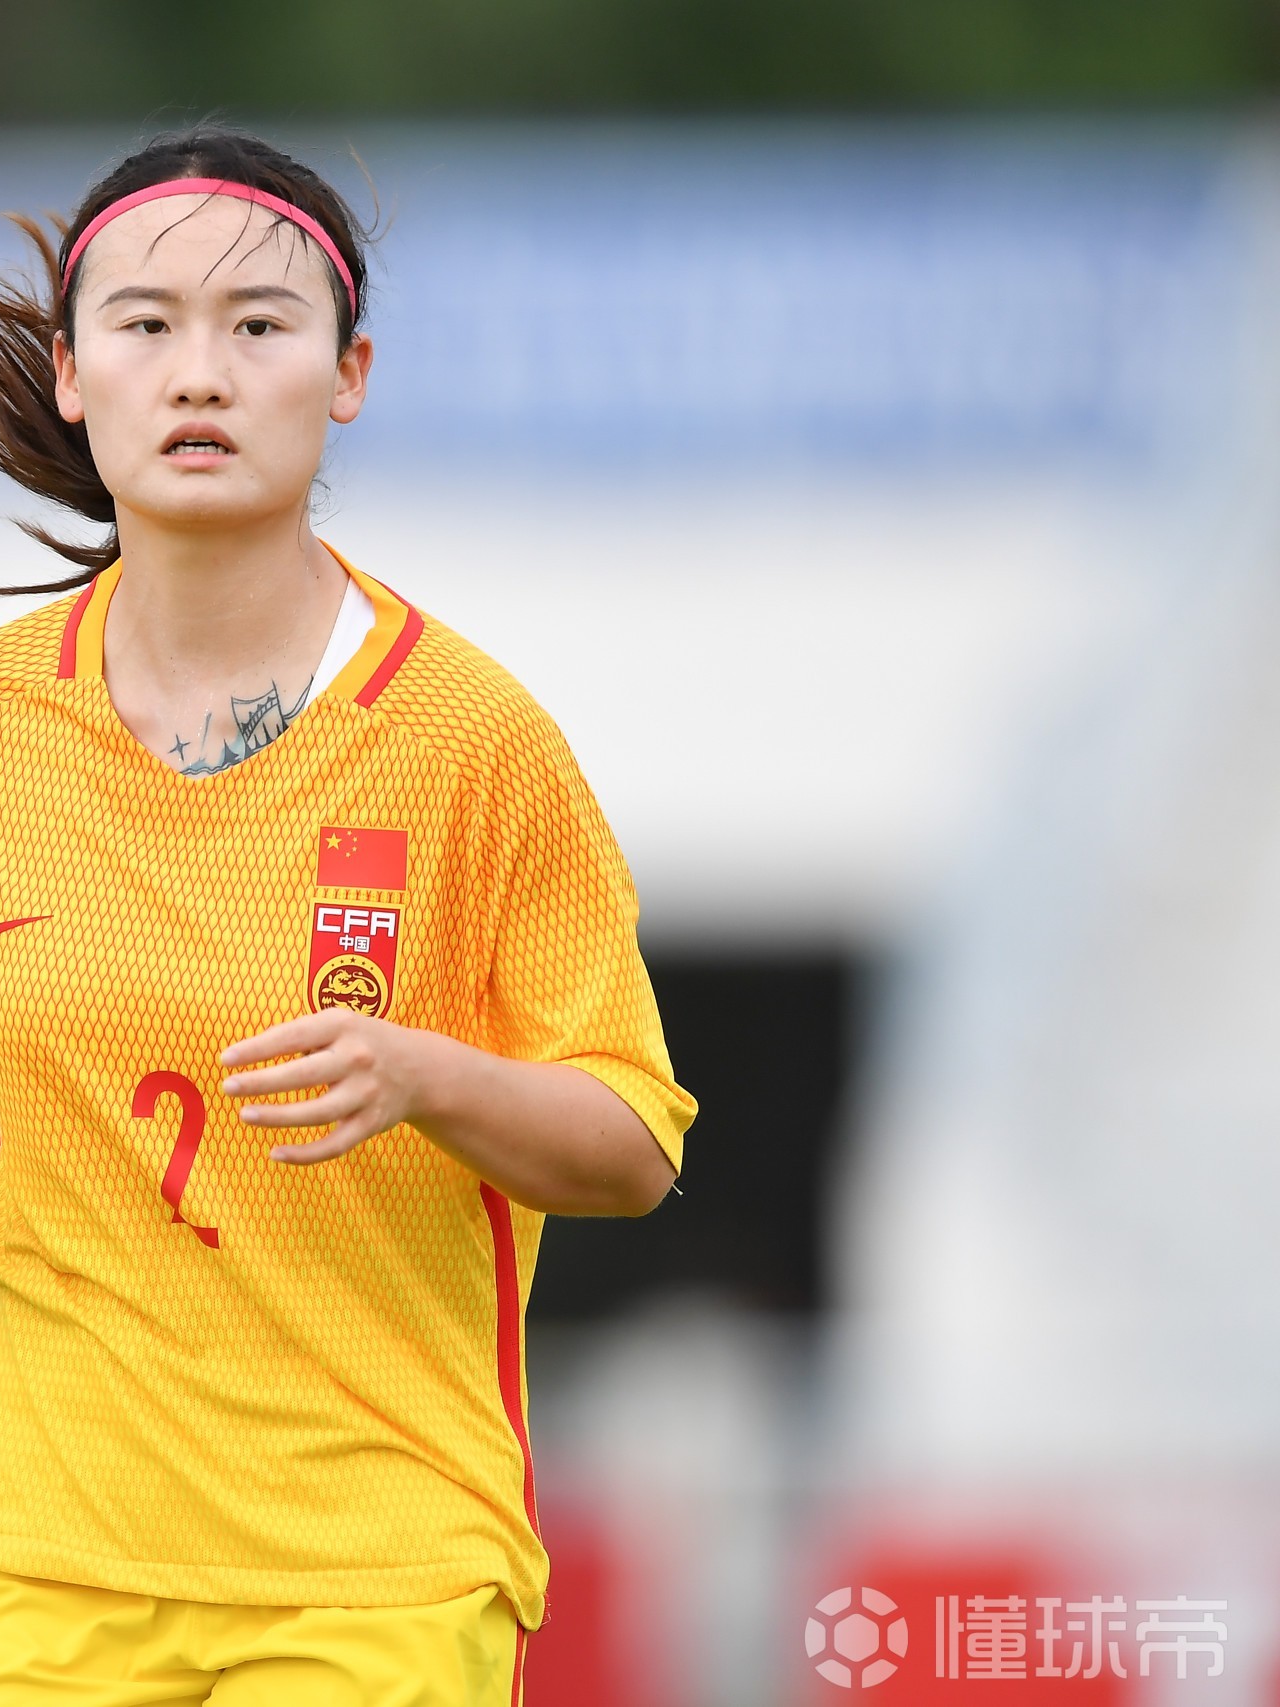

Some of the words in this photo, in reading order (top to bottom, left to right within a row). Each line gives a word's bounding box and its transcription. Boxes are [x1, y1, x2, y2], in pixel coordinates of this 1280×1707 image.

[316, 907, 396, 937] CFA
[338, 934, 370, 953] 中国
[131, 1070, 220, 1250] 2
